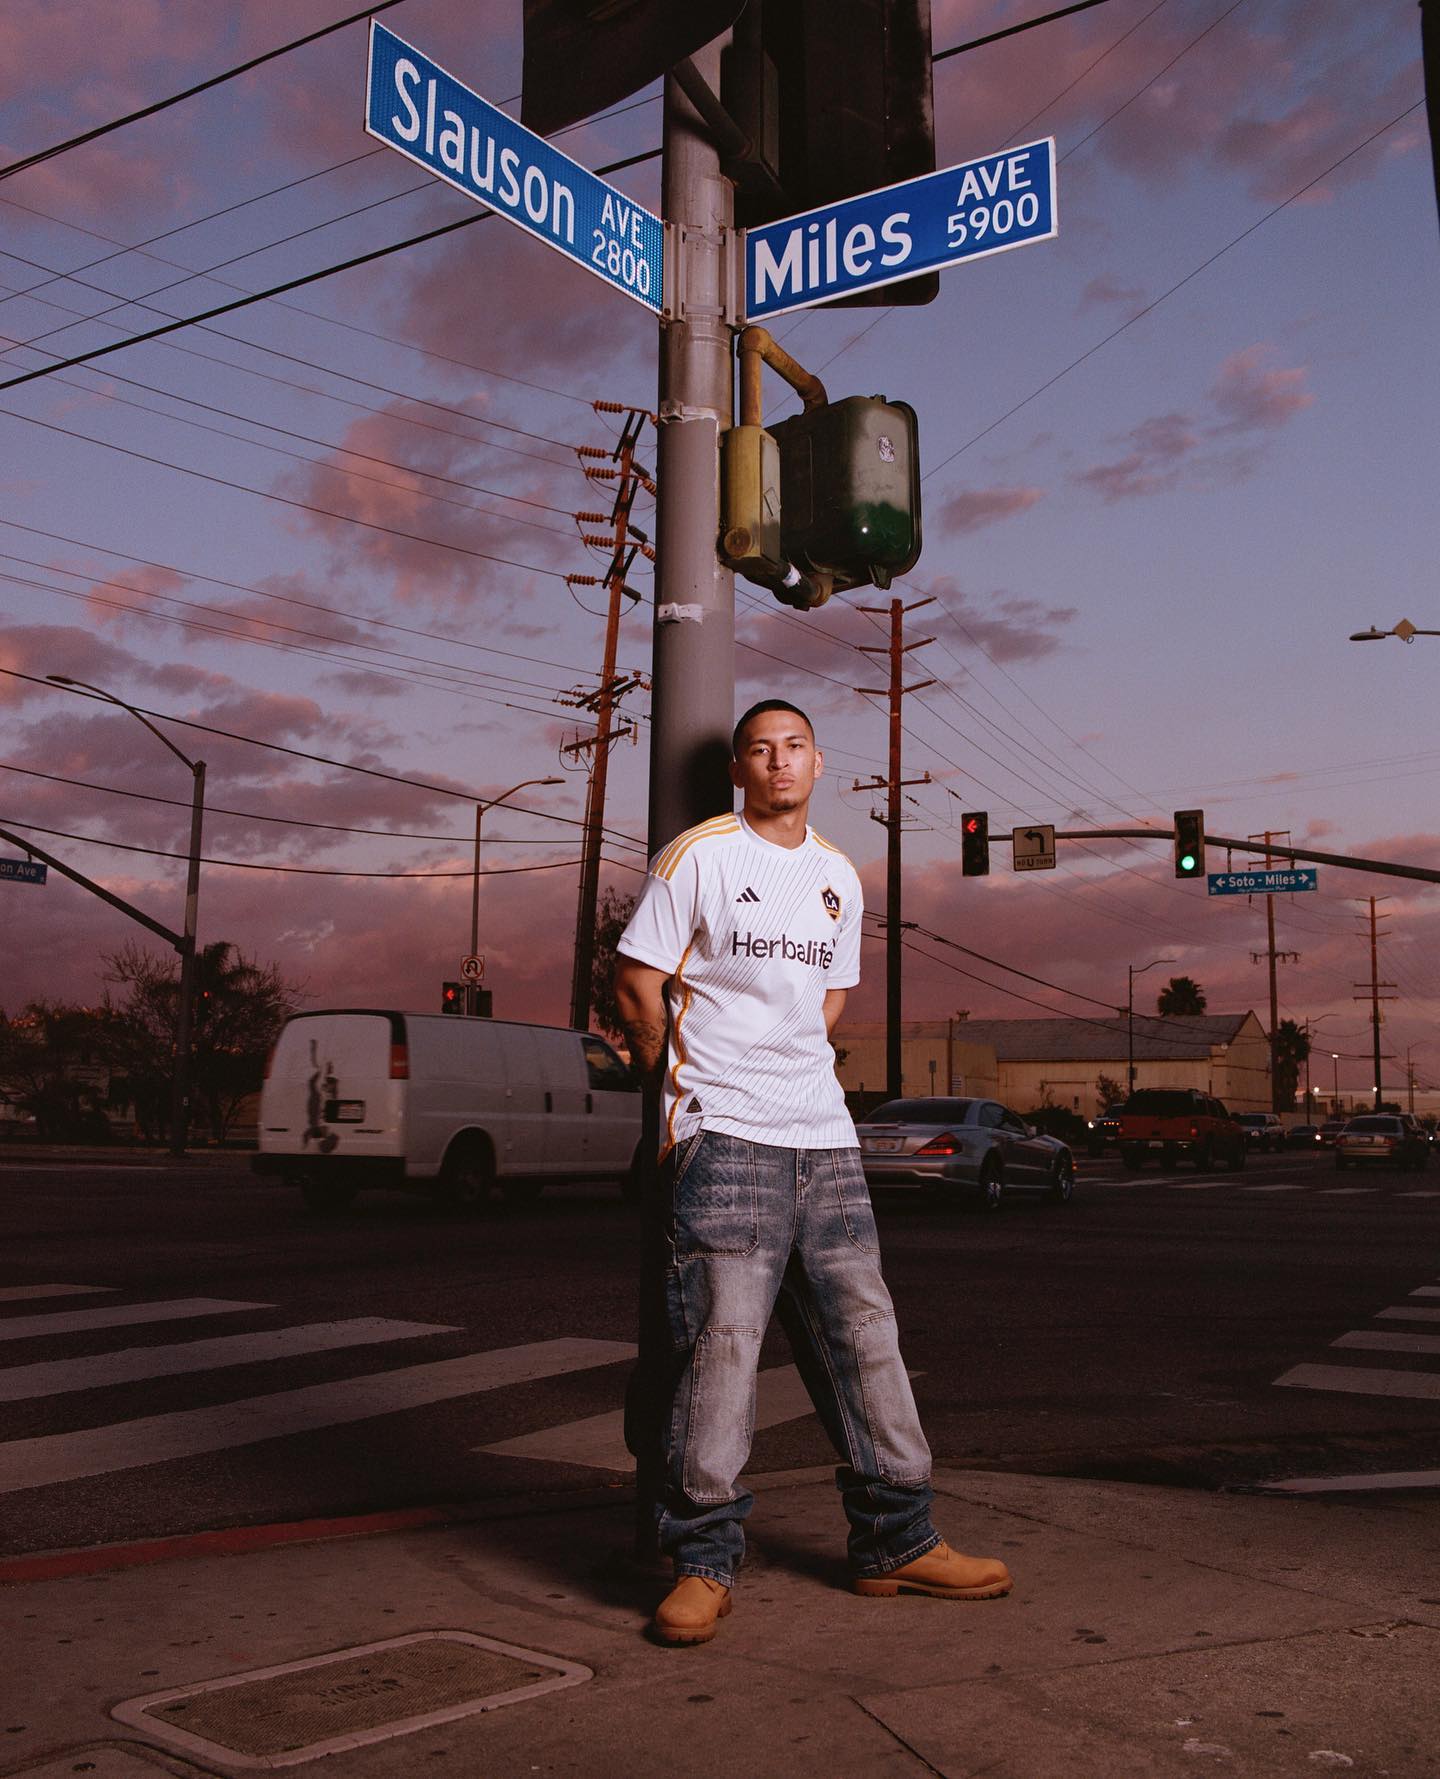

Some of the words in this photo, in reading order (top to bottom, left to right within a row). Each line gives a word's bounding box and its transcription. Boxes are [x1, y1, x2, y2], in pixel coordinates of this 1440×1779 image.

[391, 58, 575, 244] Slauson
[956, 153, 1032, 206] AVE
[601, 193, 644, 250] AVE
[947, 193, 1040, 248] 5900
[592, 229, 651, 296] 2800
[755, 212, 913, 305] Miles
[17, 864, 36, 877] Ave
[1027, 858, 1034, 867] U
[1229, 876, 1255, 887] Soto
[1265, 873, 1296, 885] Miles
[824, 896, 838, 910] LA
[732, 931, 833, 970] Herbalife
